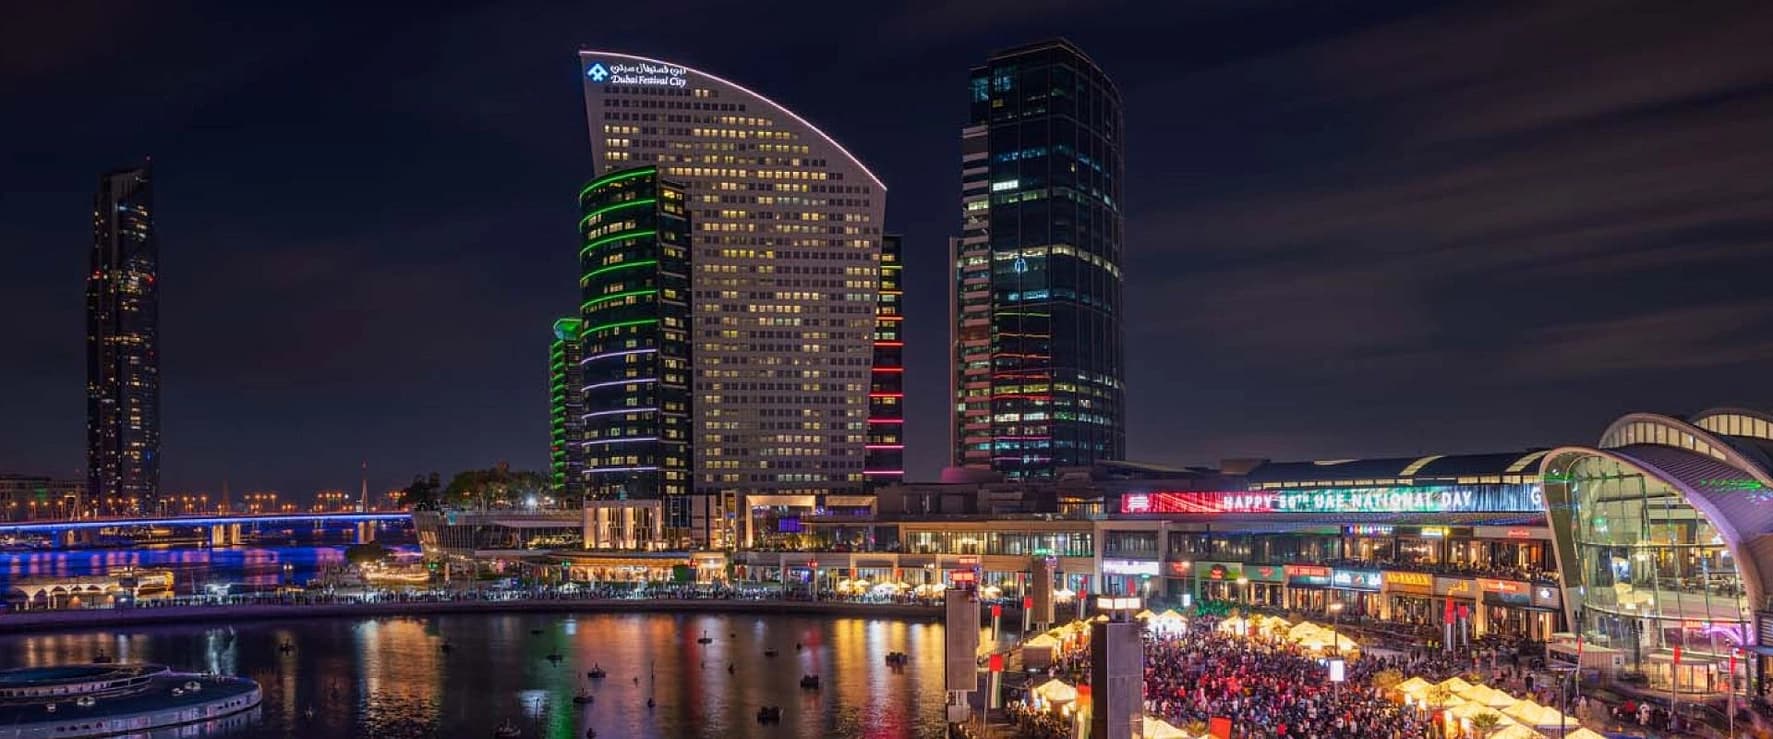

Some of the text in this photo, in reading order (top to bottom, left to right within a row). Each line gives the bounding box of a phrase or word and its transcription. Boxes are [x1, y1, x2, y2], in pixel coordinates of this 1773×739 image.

[670, 67, 687, 76] دبي
[610, 74, 687, 88] Dubai Festival City
[1223, 495, 1272, 509] HAPPY
[1313, 493, 1345, 508] UAE
[1352, 491, 1431, 508] NATIONAL
[1441, 491, 1472, 507] DAY
